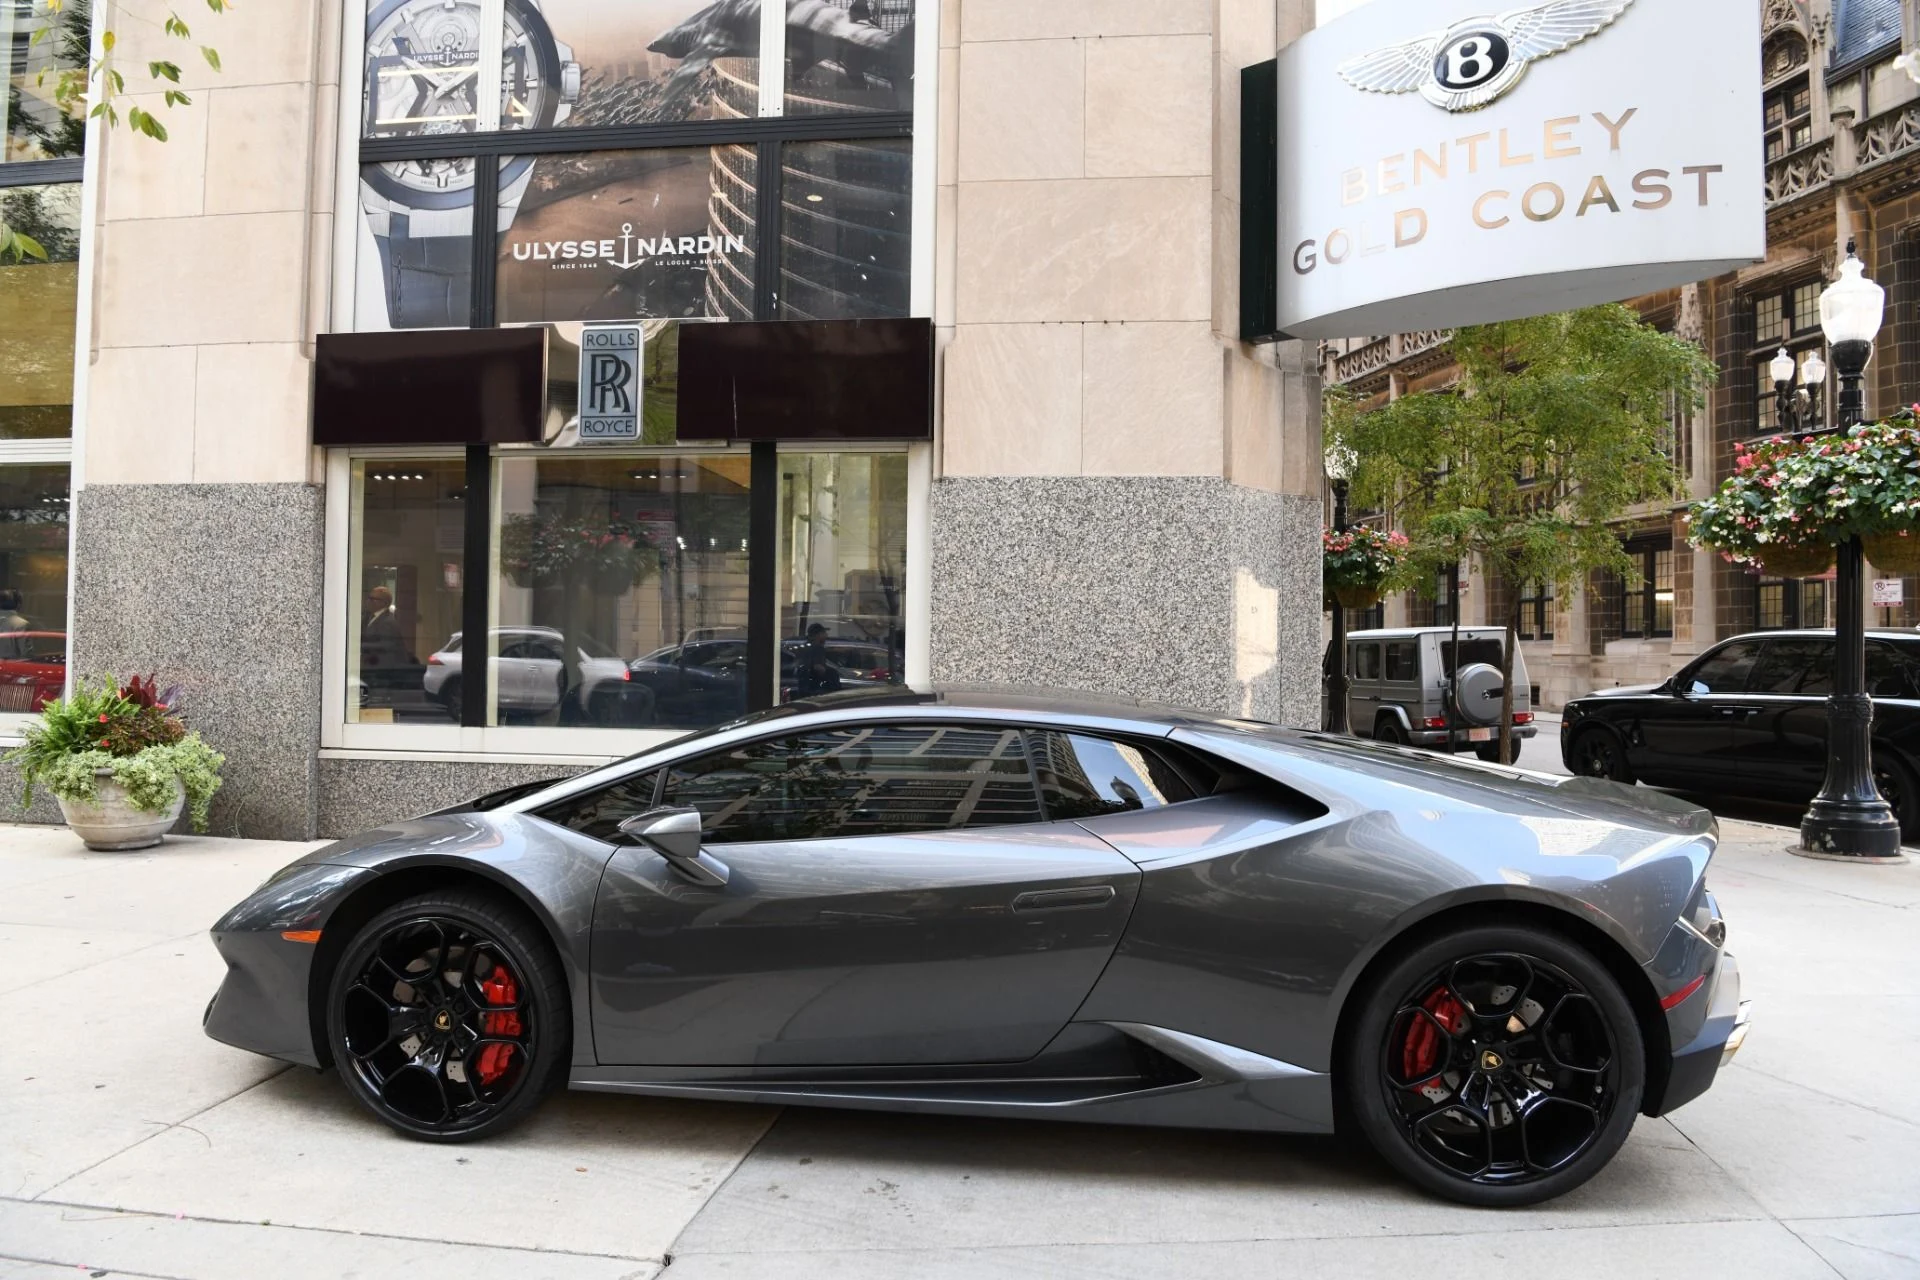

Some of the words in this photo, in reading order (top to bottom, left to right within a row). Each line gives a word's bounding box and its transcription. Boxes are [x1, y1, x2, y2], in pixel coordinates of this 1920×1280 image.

[413, 54, 444, 62] ULYSSE
[452, 52, 479, 60] NARDI
[1446, 36, 1494, 84] B
[1341, 108, 1638, 206] BENTLEY
[1293, 208, 1428, 275] GOLD
[1472, 164, 1723, 230] COAST
[513, 239, 616, 261] ULYSSE
[637, 235, 744, 256] NARDIN
[586, 333, 635, 346] ROLLS
[584, 420, 633, 433] ROYCE
